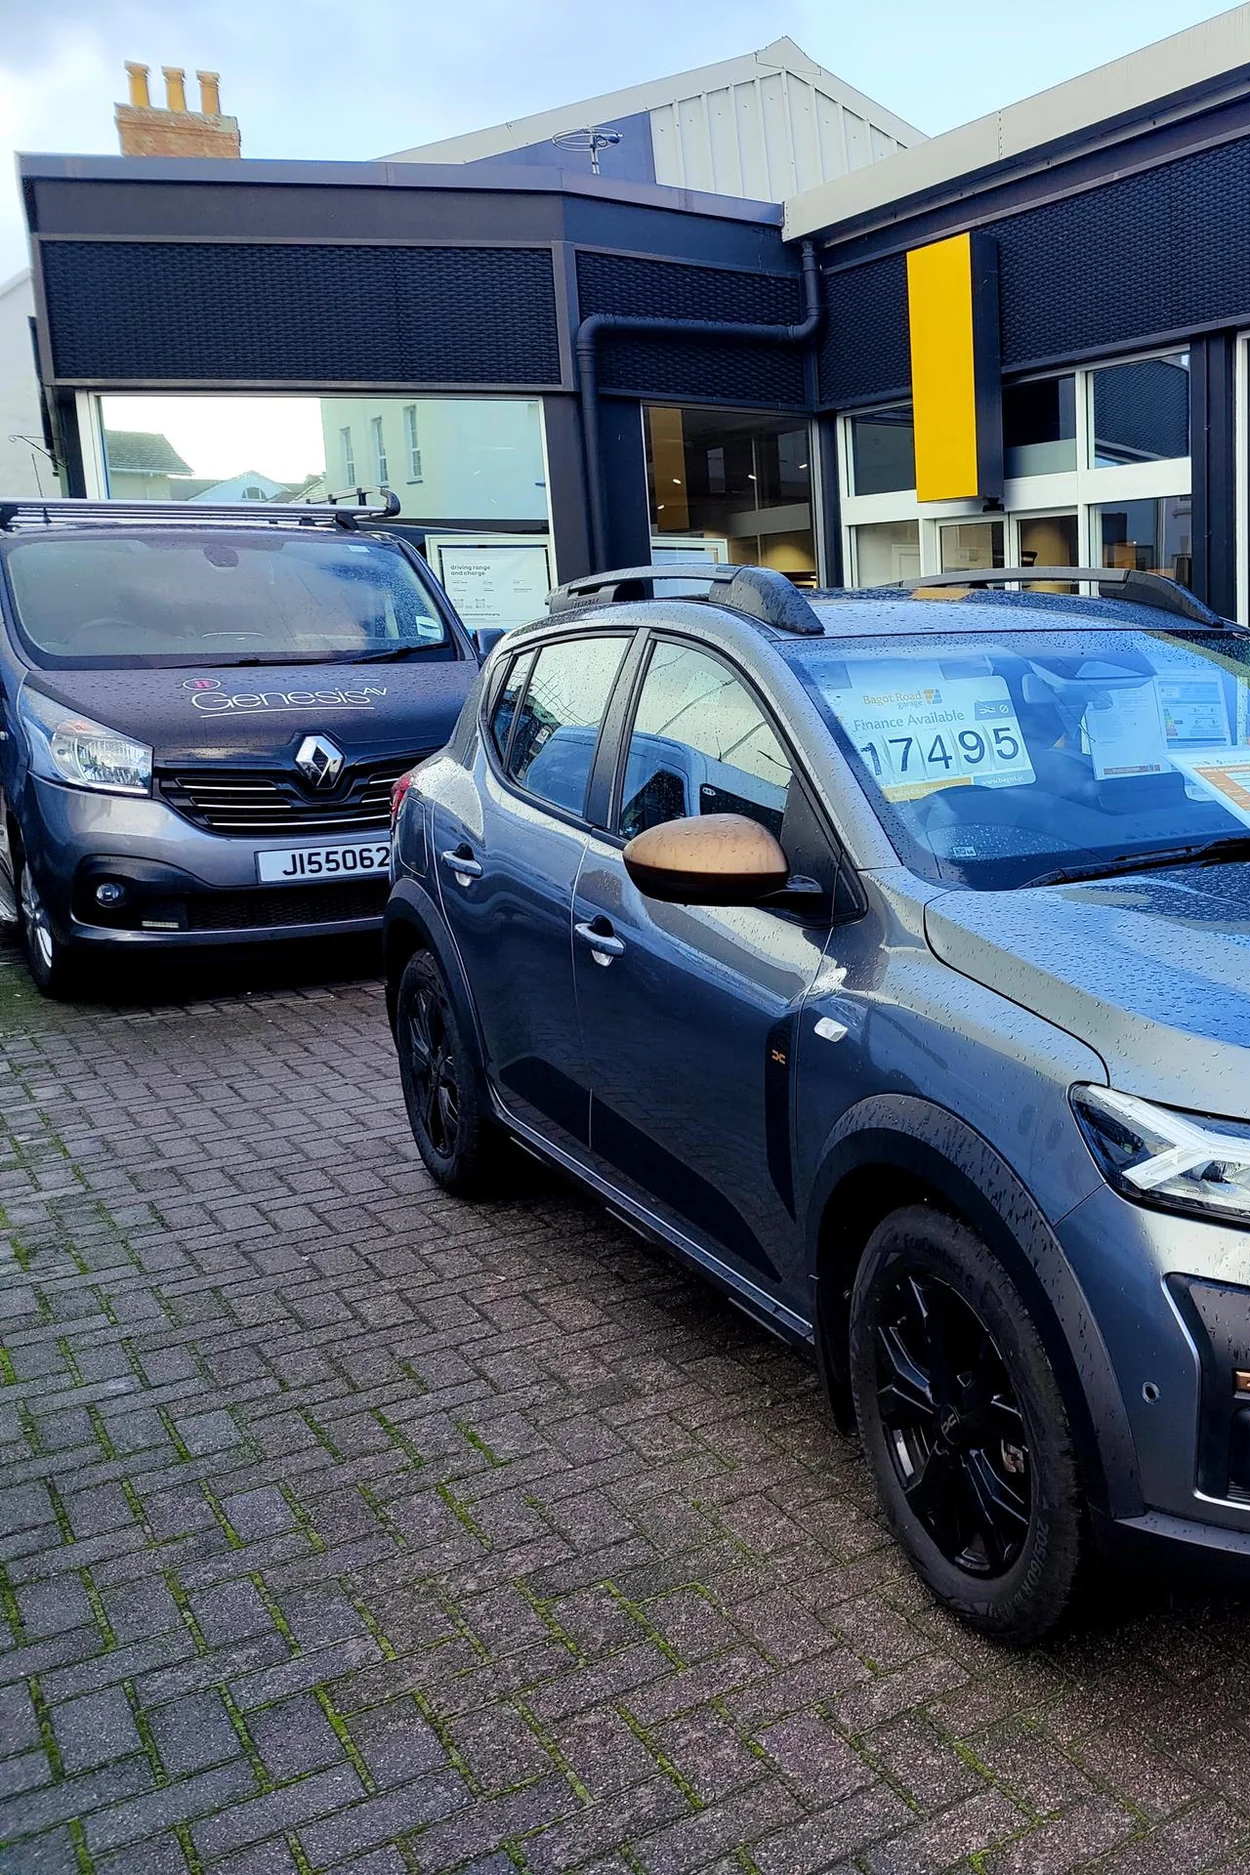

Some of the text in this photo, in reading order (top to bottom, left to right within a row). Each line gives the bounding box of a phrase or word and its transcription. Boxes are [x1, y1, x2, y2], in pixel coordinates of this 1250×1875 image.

[863, 690, 923, 707] Bagot Road
[897, 700, 923, 710] garage
[852, 710, 965, 732] Finance Available
[860, 727, 1019, 776] 17495
[282, 846, 390, 876] J155062
